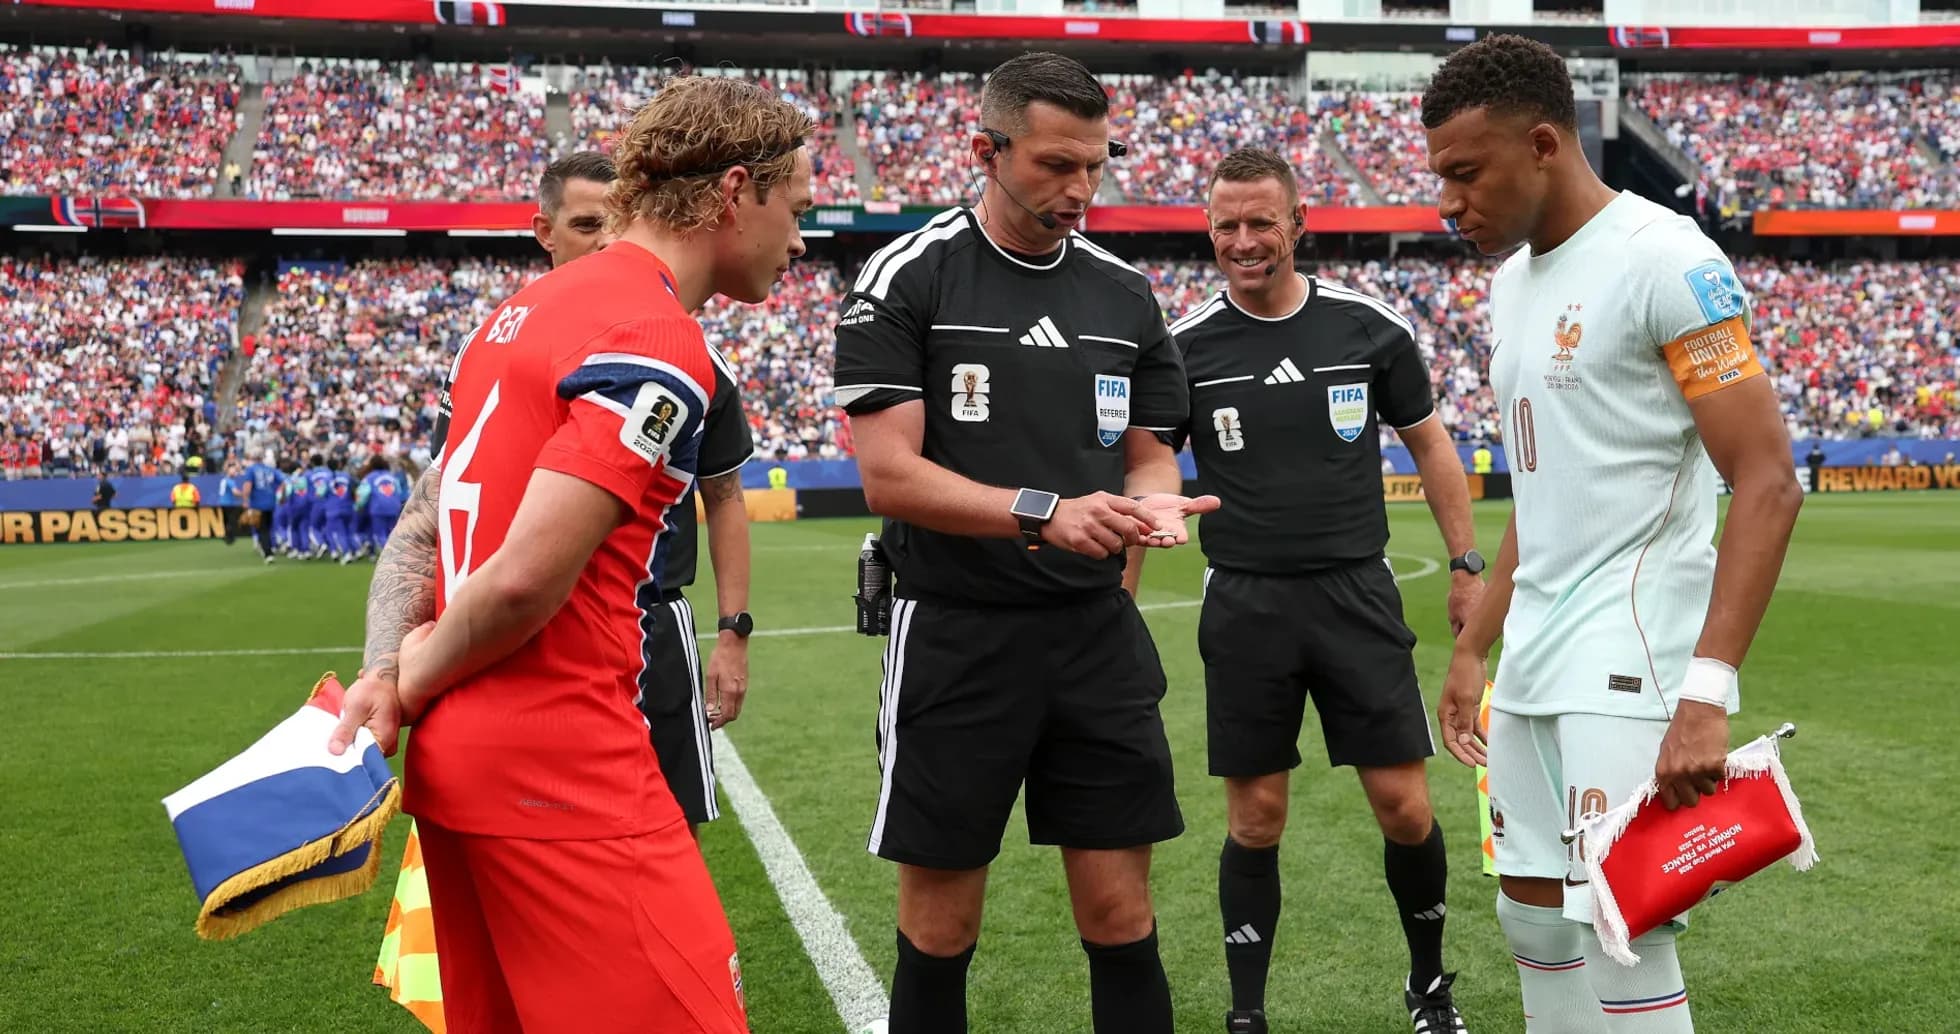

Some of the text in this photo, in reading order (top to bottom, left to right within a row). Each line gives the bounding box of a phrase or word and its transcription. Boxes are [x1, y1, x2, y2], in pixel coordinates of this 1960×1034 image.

[485, 304, 538, 344] BER
[858, 315, 875, 323] ONE
[1684, 326, 1734, 353] FOOTBALL
[1689, 336, 1740, 366] UNITES
[1694, 350, 1749, 379] the World
[1719, 370, 1740, 382] FIFA
[1098, 380, 1126, 398] FIFA
[1332, 387, 1364, 403] FIFA
[1100, 408, 1127, 419] REFEREE
[647, 428, 661, 441] FIFA
[1512, 397, 1537, 472] 10
[1818, 466, 1931, 491] REWARD
[0, 507, 226, 544] R PASSION
[1683, 824, 1705, 839] Boston
[1692, 832, 1707, 843] June
[1661, 823, 1743, 874] NORWAY vs FRANCE
[1721, 839, 1736, 850] FIFA
[1692, 856, 1706, 866] Cup
[1704, 846, 1723, 860] World
